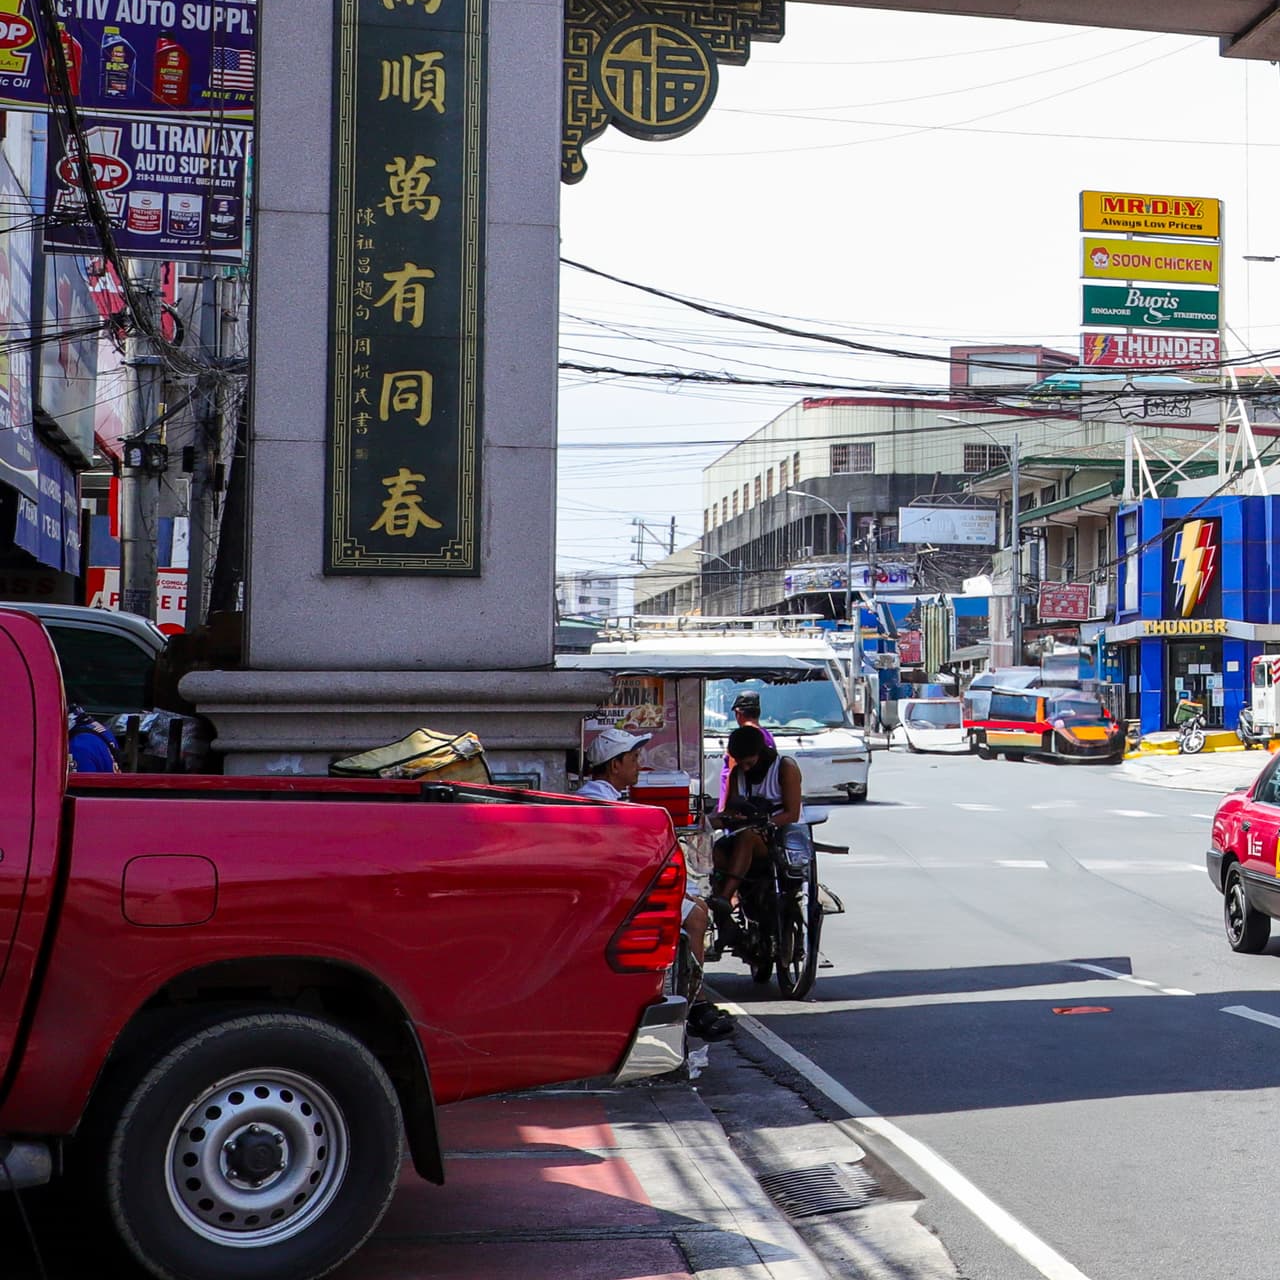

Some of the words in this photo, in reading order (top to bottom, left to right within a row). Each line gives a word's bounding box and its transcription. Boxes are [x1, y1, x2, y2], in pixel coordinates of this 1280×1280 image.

[181, 3, 255, 35] SUPPL
[135, 152, 176, 174] AUTO
[1101, 217, 1142, 228] Always
[1144, 219, 1166, 229] Low
[1168, 221, 1203, 231] Prices
[1112, 254, 1152, 268] SOON
[1125, 288, 1180, 324] Bugis
[1112, 335, 1218, 360] THUNDER
[1143, 619, 1228, 635] THUNDER
